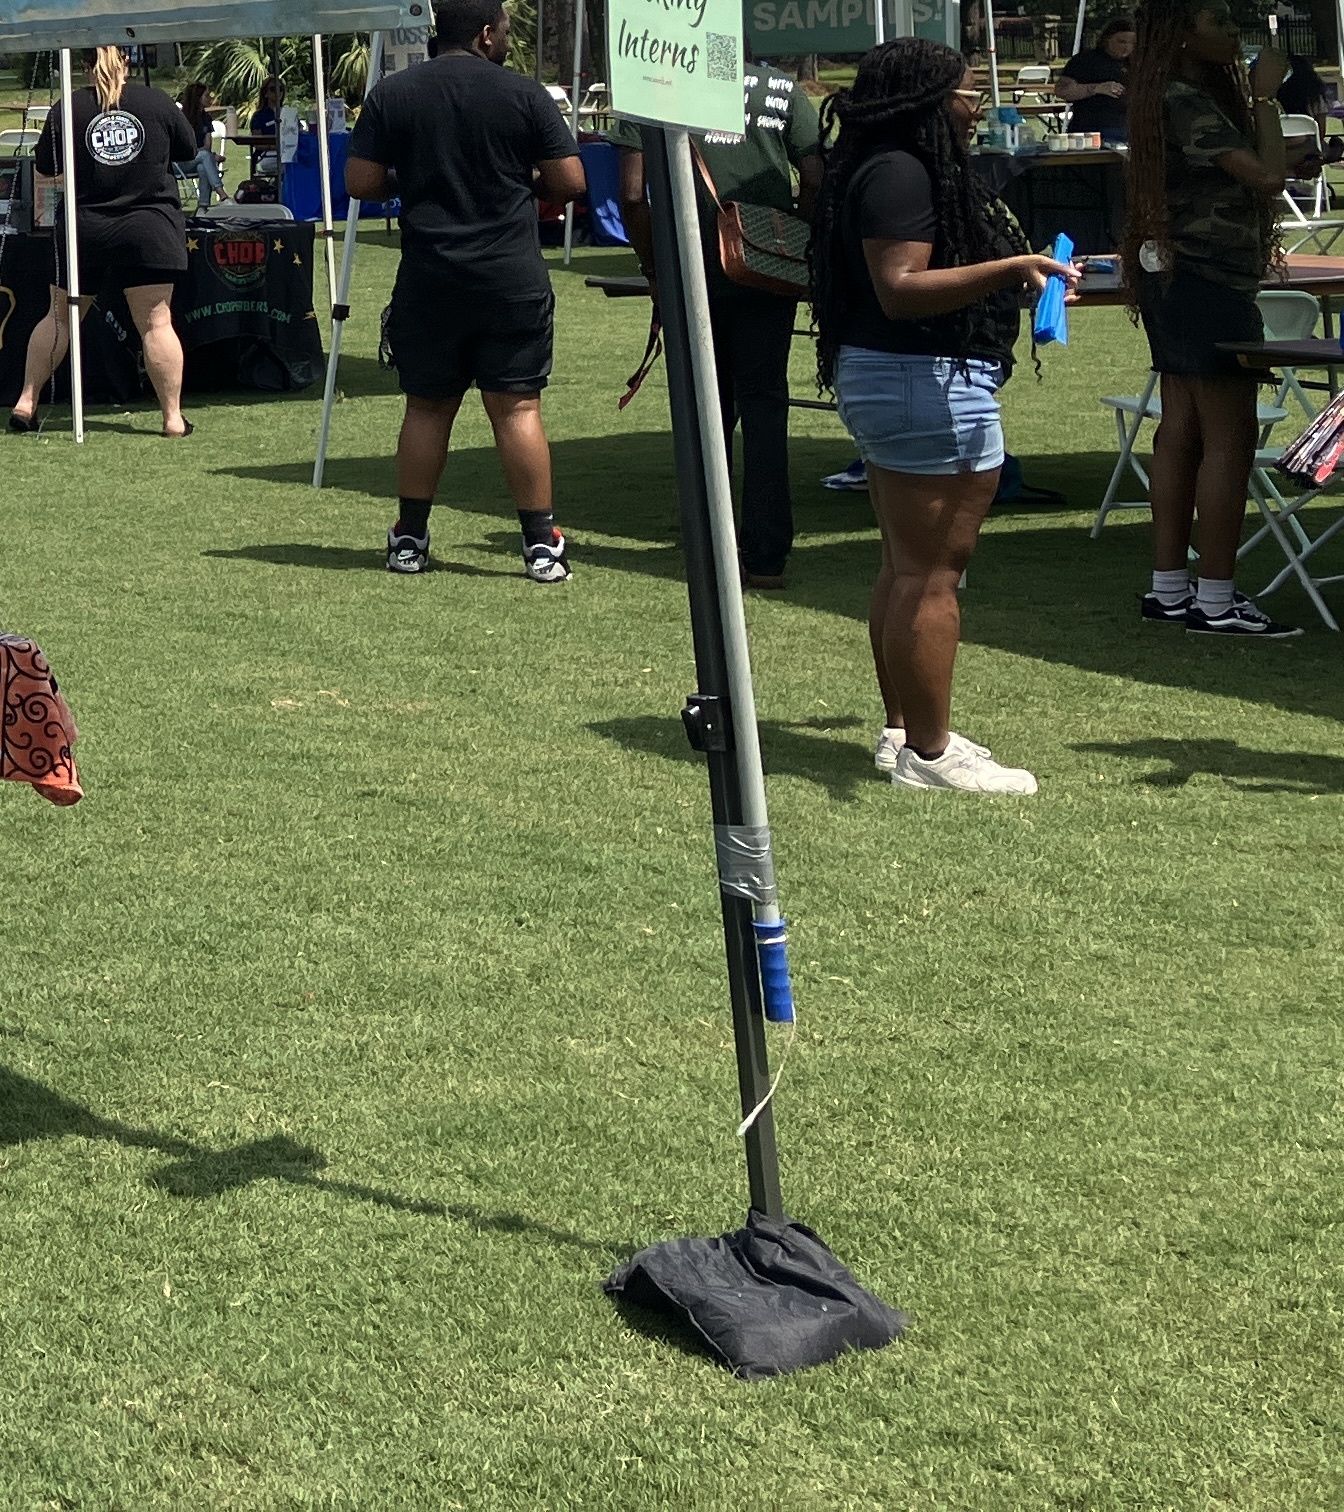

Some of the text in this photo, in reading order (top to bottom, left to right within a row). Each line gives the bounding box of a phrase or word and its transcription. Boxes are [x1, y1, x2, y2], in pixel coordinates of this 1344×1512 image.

[618, 18, 700, 74] Interns
[768, 76, 794, 92] WITH
[92, 128, 138, 148] CHOP
[214, 242, 265, 265] CHOP
